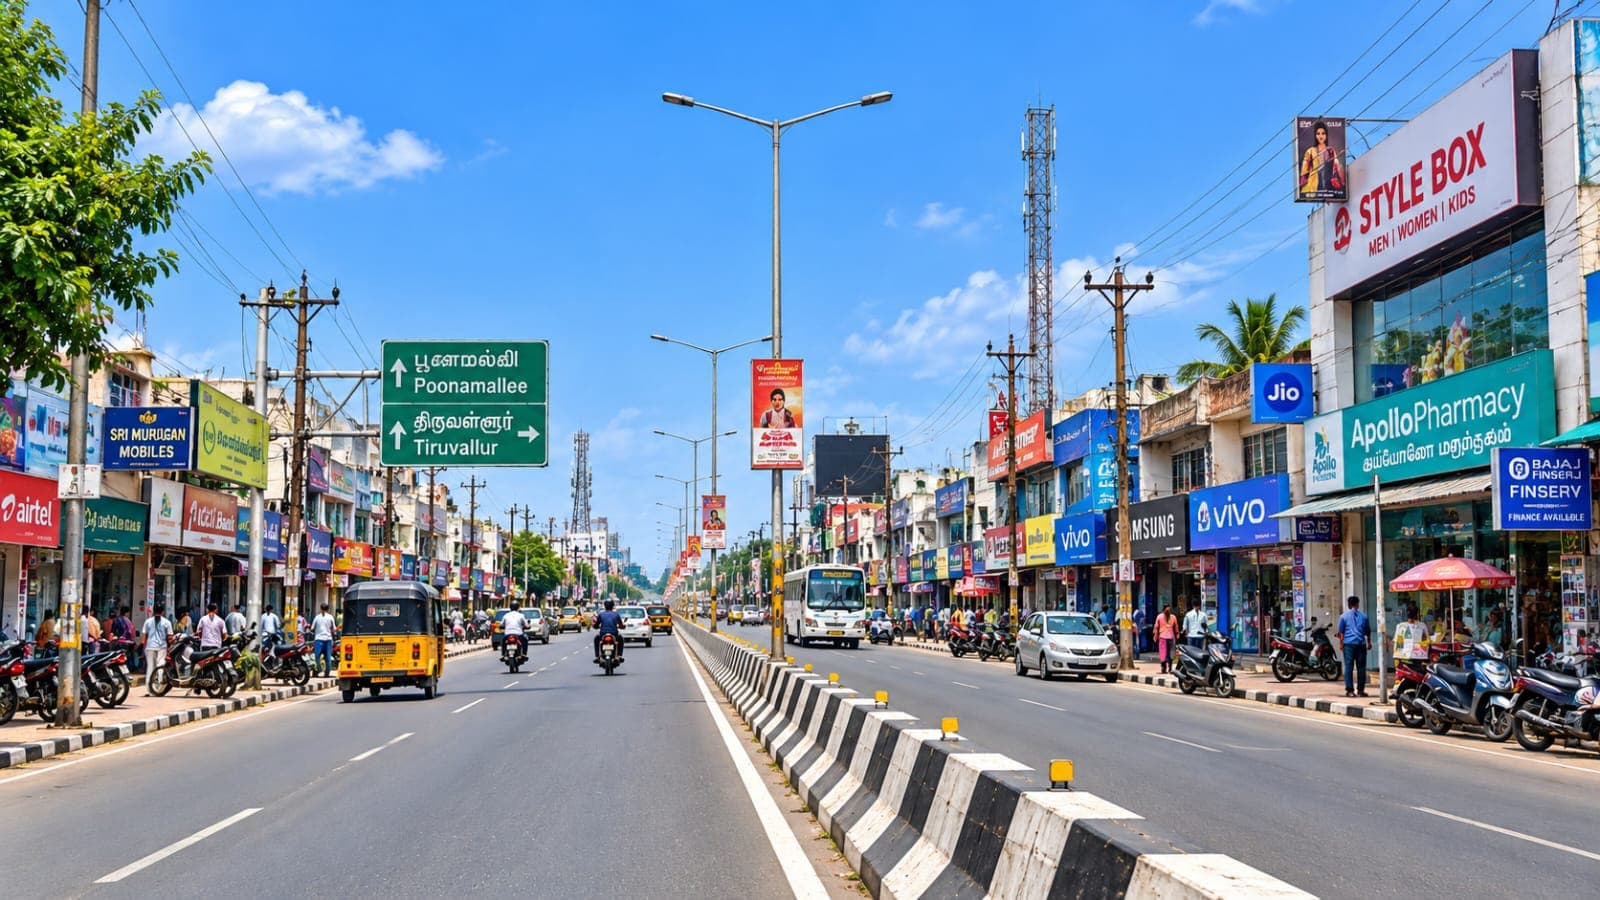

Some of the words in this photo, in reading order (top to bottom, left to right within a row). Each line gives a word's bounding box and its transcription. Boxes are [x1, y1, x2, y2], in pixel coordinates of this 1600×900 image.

[1359, 160, 1424, 235] STYLE
[1431, 122, 1487, 195] BOX
[1369, 235, 1389, 257] MEN
[1397, 205, 1438, 241] WOMEN
[1448, 185, 1476, 216] KIDS
[414, 377, 528, 394] Poonamallee
[1267, 381, 1300, 401] Jio
[110, 428, 129, 441] SRI
[119, 445, 174, 458] MOBILES
[413, 439, 498, 456] Tiruvallur
[1532, 458, 1581, 469] BAJAJ
[1510, 485, 1582, 498] FINSERV
[16, 496, 52, 527] airtel
[1213, 495, 1265, 529] vivo
[1061, 524, 1090, 552] vivo
[1115, 513, 1175, 543] SMSUNG
